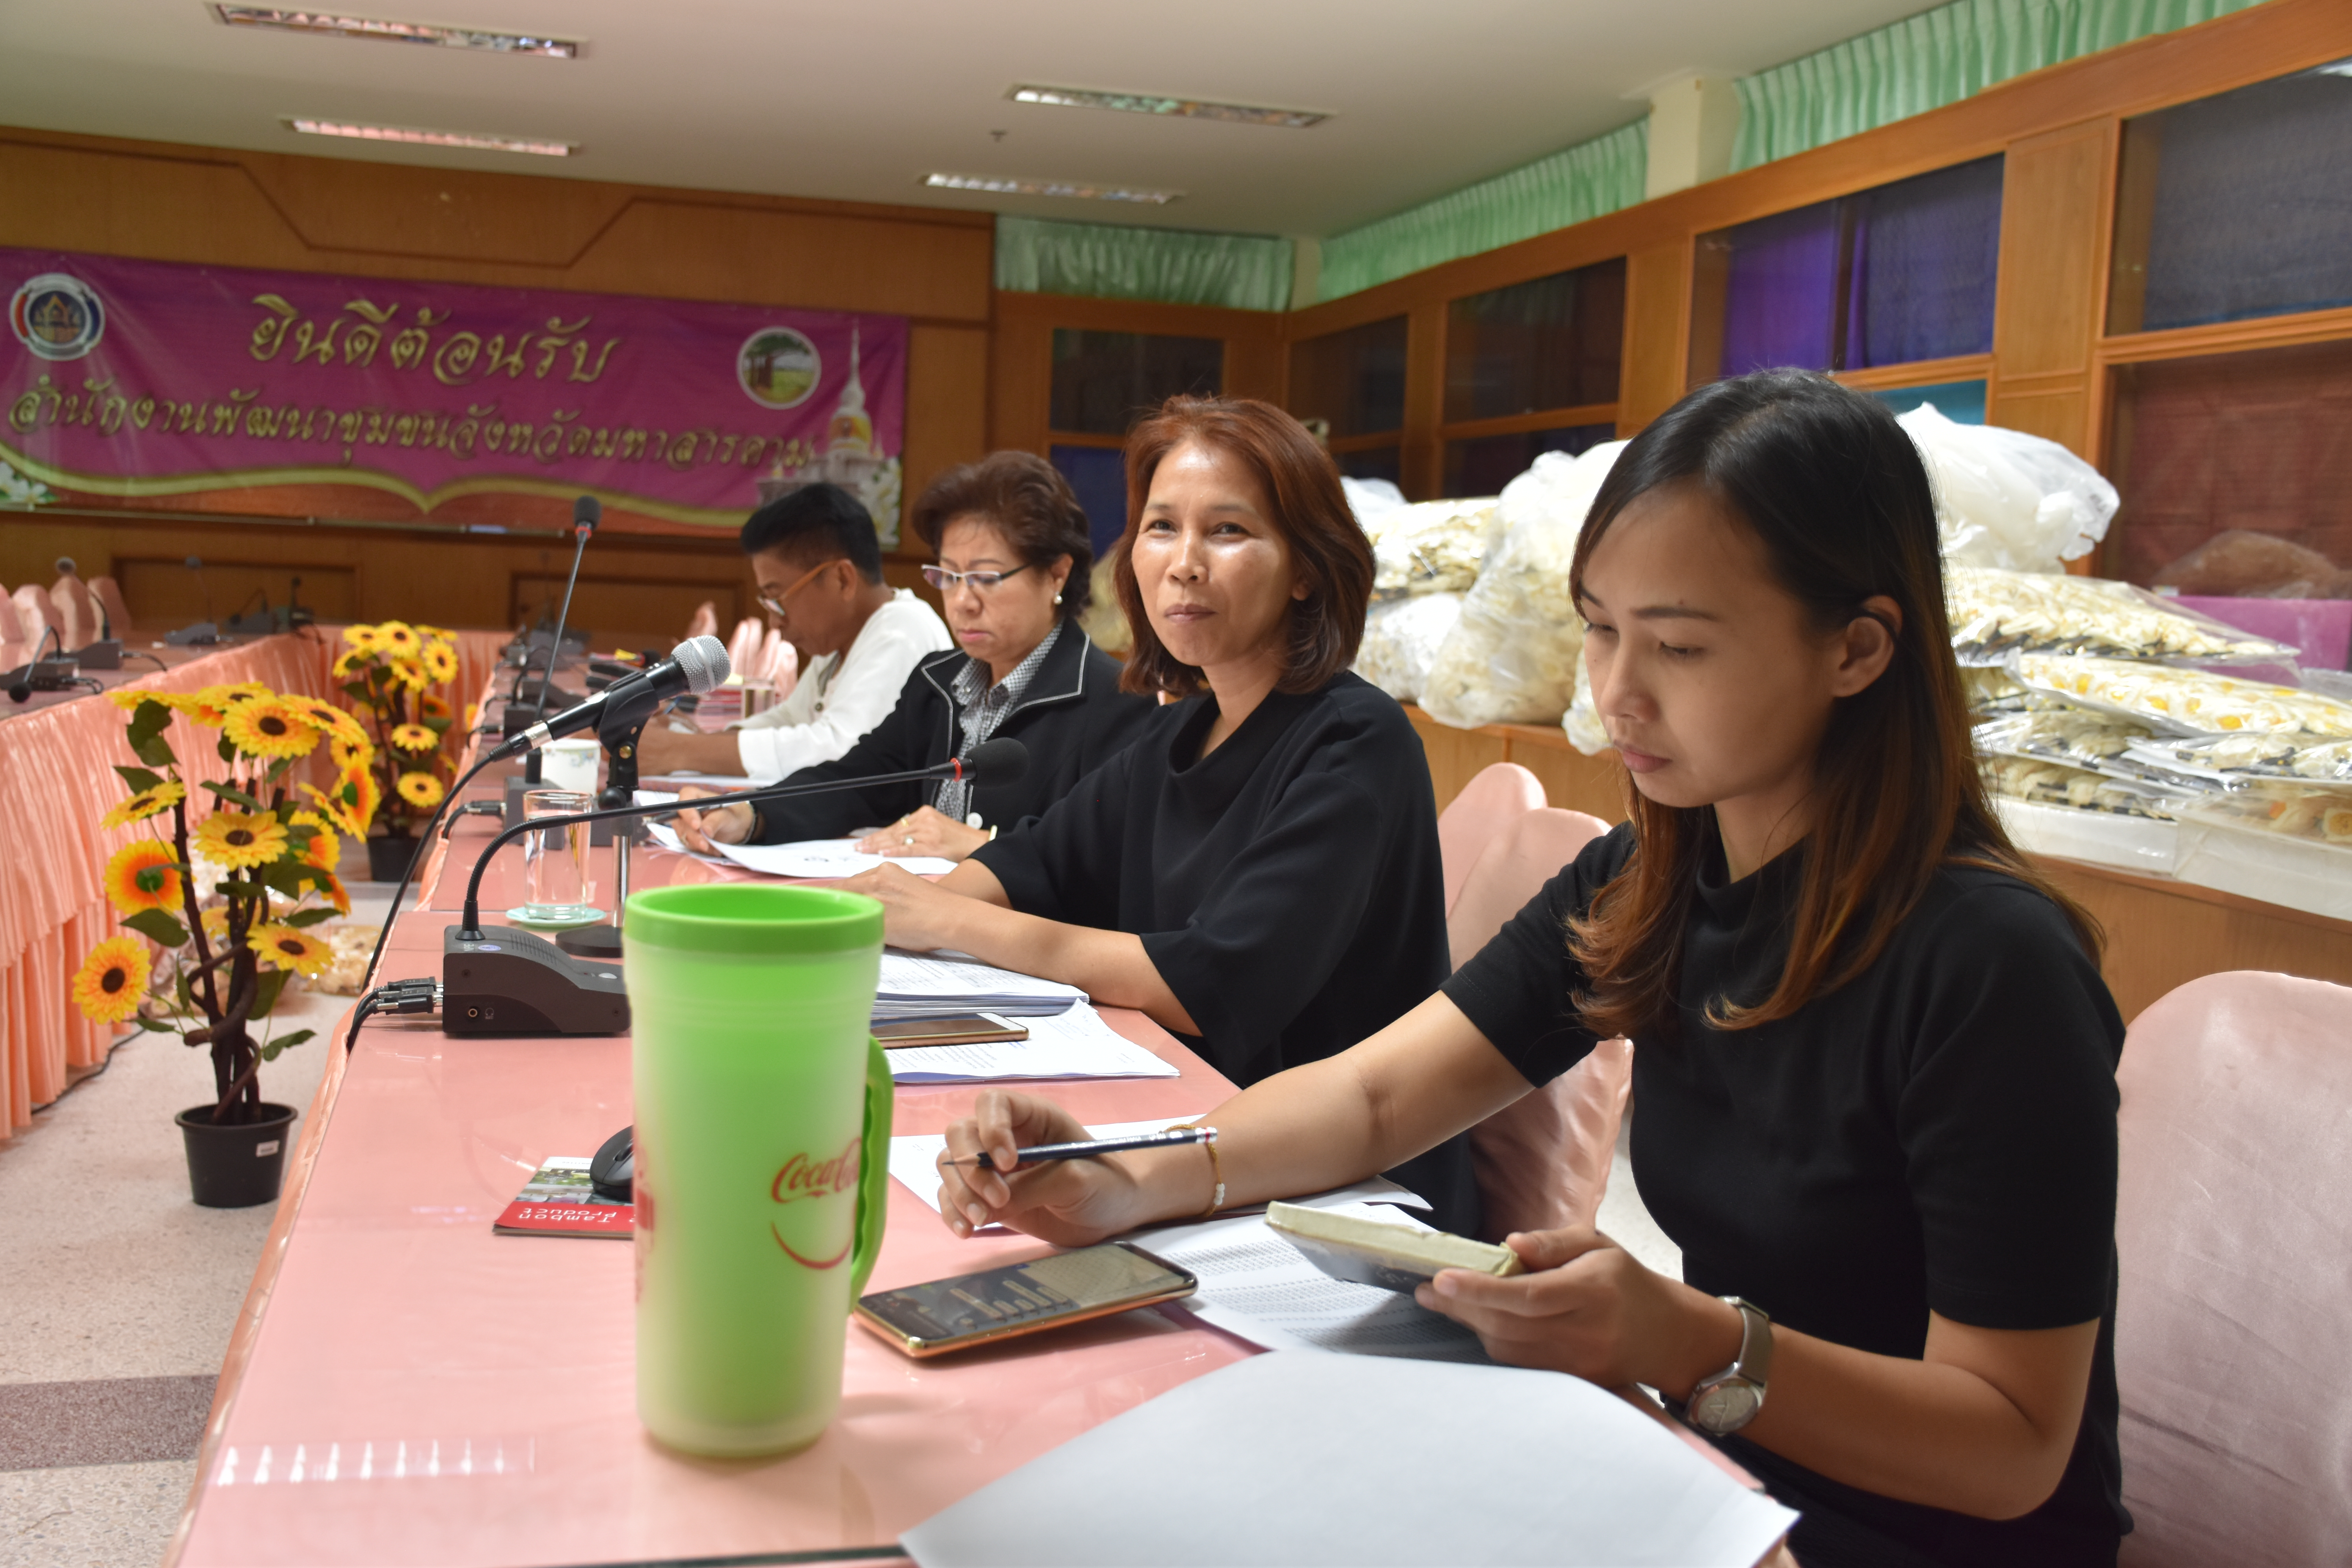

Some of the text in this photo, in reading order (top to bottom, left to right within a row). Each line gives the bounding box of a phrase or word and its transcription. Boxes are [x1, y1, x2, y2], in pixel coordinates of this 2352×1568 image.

[249, 293, 621, 386] ยินดีต้อนรับ
[9, 373, 818, 470] สำนักงานพัฒนาชุมชนจังหวัดมหาสารคาม
[519, 1214, 610, 1222] Tambon
[523, 1208, 617, 1217] Product
